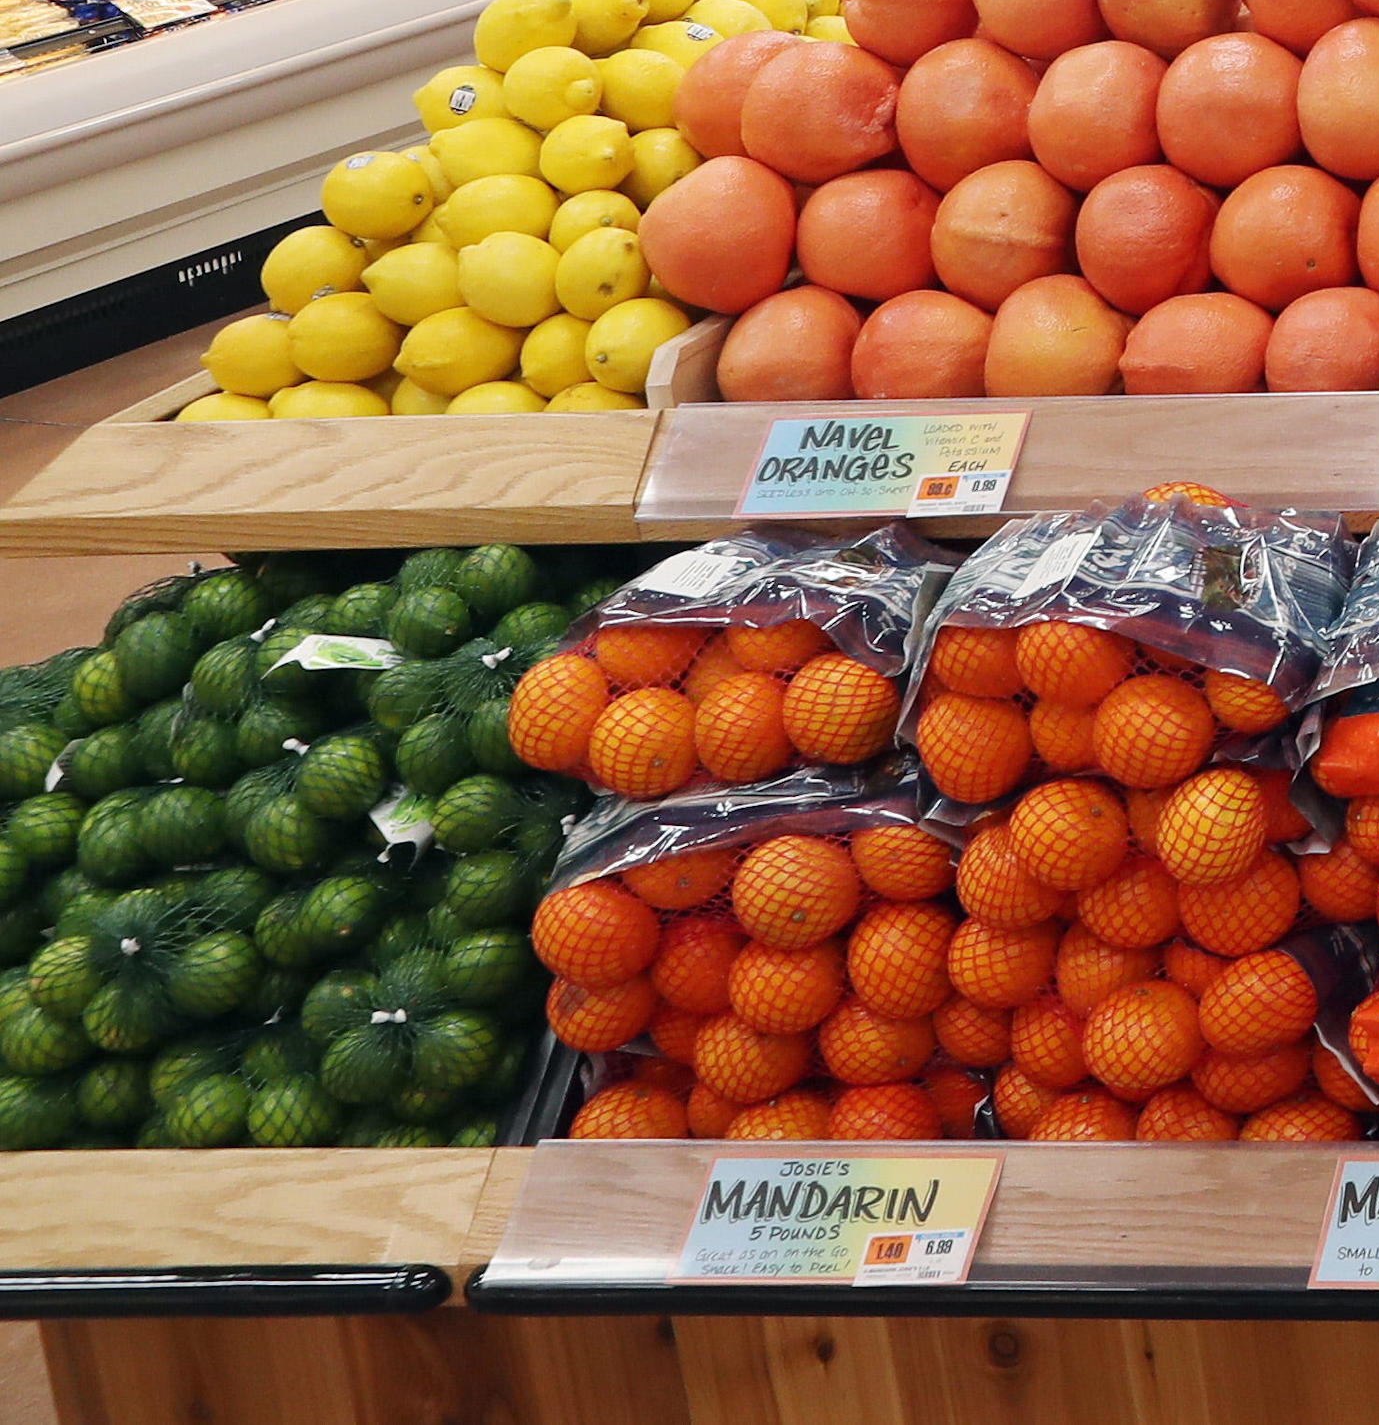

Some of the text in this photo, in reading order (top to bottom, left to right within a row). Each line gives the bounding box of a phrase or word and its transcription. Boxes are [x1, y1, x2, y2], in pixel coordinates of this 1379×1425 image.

[947, 460, 988, 473] EACH
[778, 1160, 851, 1177] JOSIE'S
[700, 1177, 941, 1225] MANDARIN
[748, 1223, 841, 1242] 5 POUNDS
[1358, 1262, 1375, 1277] to
